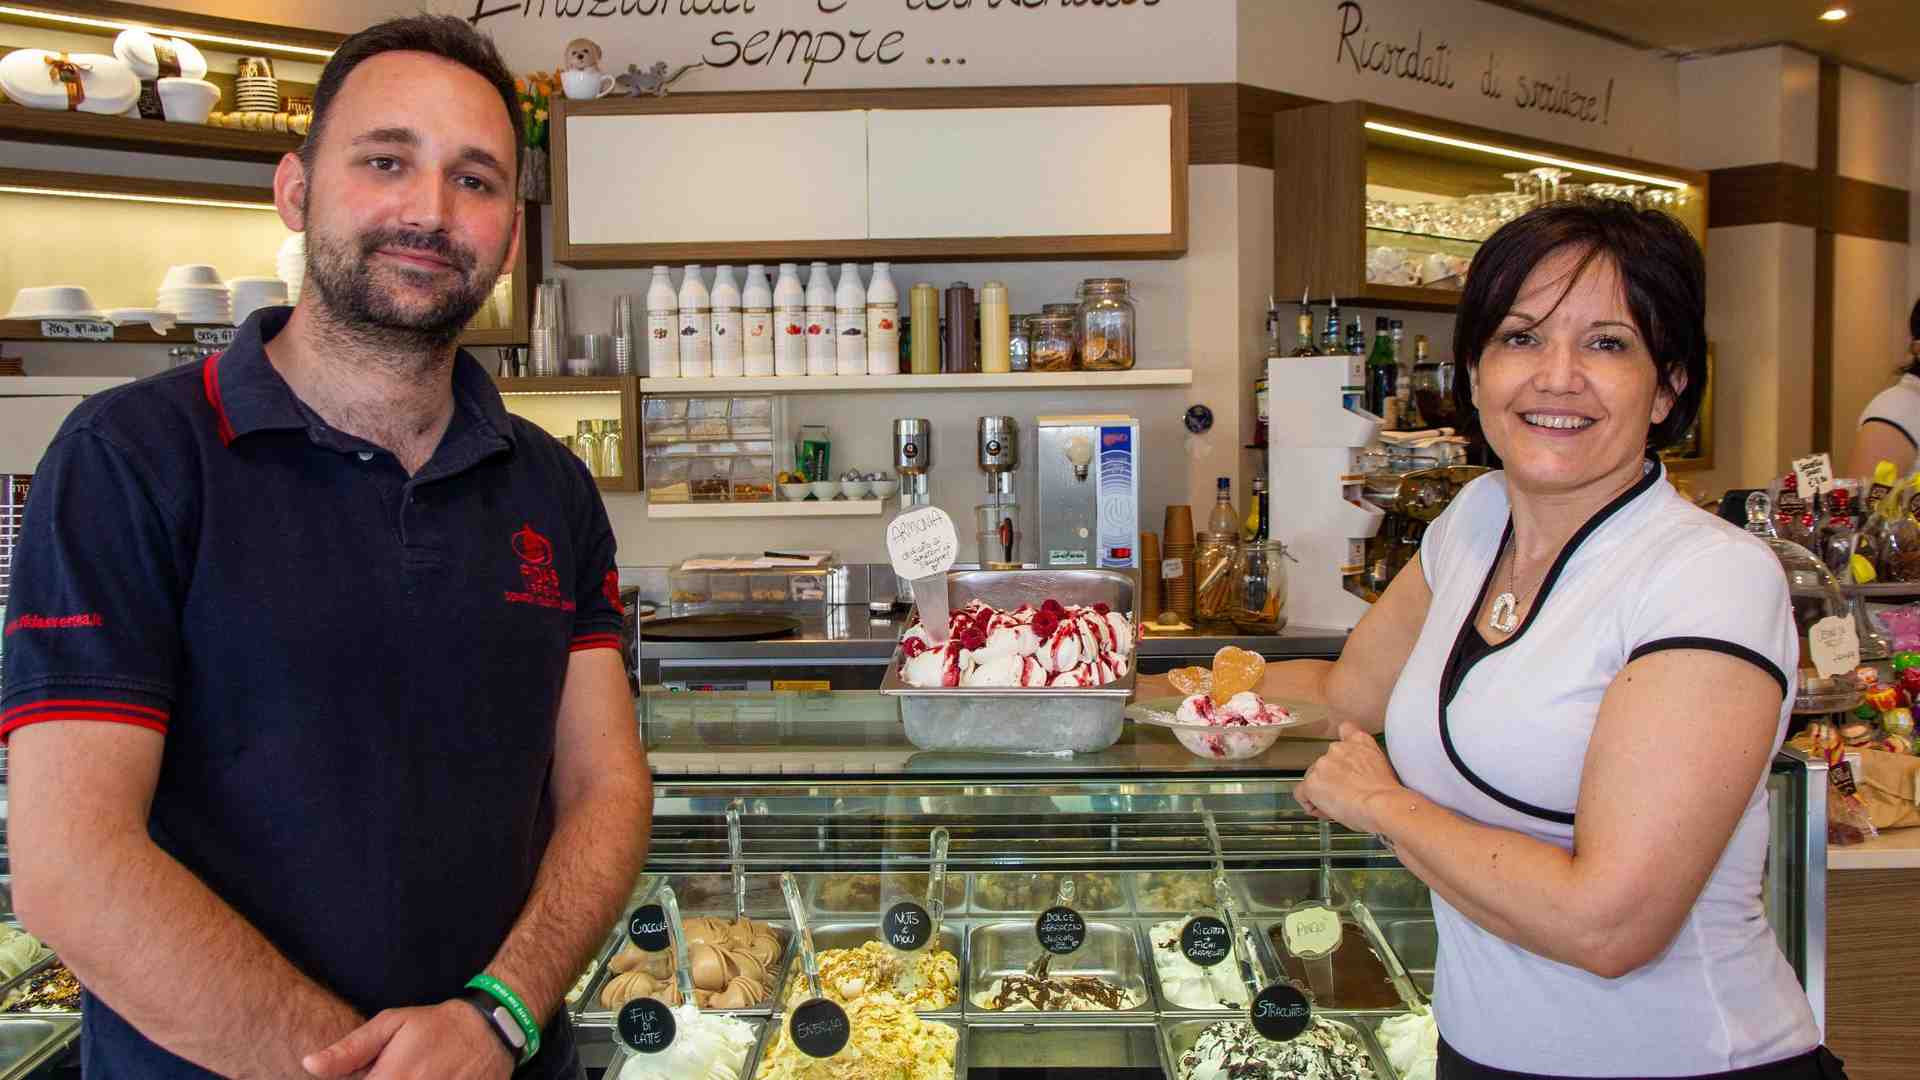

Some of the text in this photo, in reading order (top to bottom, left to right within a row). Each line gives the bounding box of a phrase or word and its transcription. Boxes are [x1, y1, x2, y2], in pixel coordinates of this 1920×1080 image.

[702, 28, 905, 86] sempre
[1336, 1, 1455, 89] Ricordati
[1480, 50, 1503, 98] di
